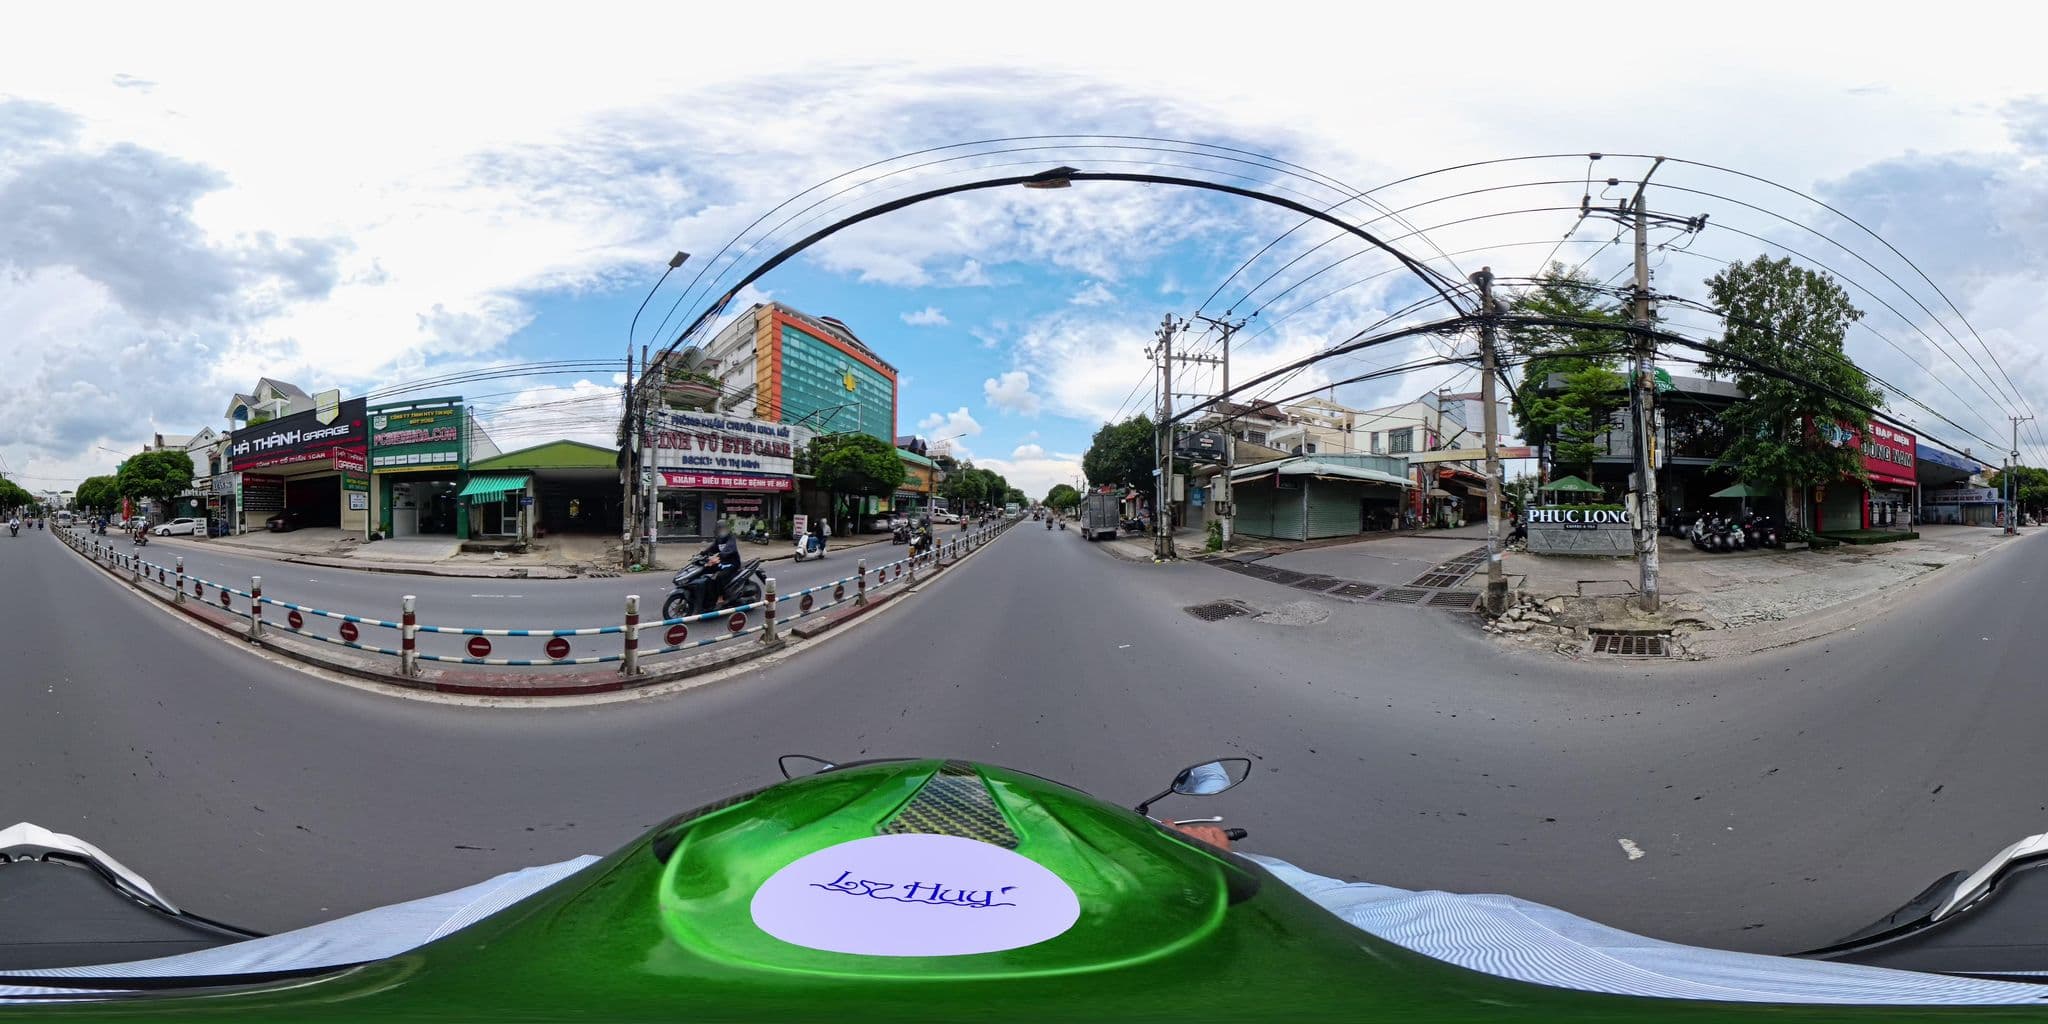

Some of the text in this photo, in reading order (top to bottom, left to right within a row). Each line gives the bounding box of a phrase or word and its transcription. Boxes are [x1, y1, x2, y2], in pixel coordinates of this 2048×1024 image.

[671, 414, 790, 438] PHÒNG KHÁM CHUYÊN KHOA MẮT
[1875, 426, 1892, 440] ĐẠP
[1893, 433, 1910, 446] ĐIỆN
[233, 424, 350, 456] HÀ THÀNH GARAGE
[696, 431, 719, 452] VŨ
[721, 435, 752, 455] EYE
[754, 439, 791, 458] CARE
[338, 460, 364, 471] GARAGE
[1892, 448, 1912, 468] NAM
[672, 475, 696, 484] KHÁM
[702, 476, 720, 486] ĐIỀU
[720, 478, 732, 488] TRỊ
[733, 478, 747, 487] CÁC
[748, 479, 766, 488] BỆNH
[777, 479, 789, 488] MẮT
[1528, 509, 1579, 523] PHUC
